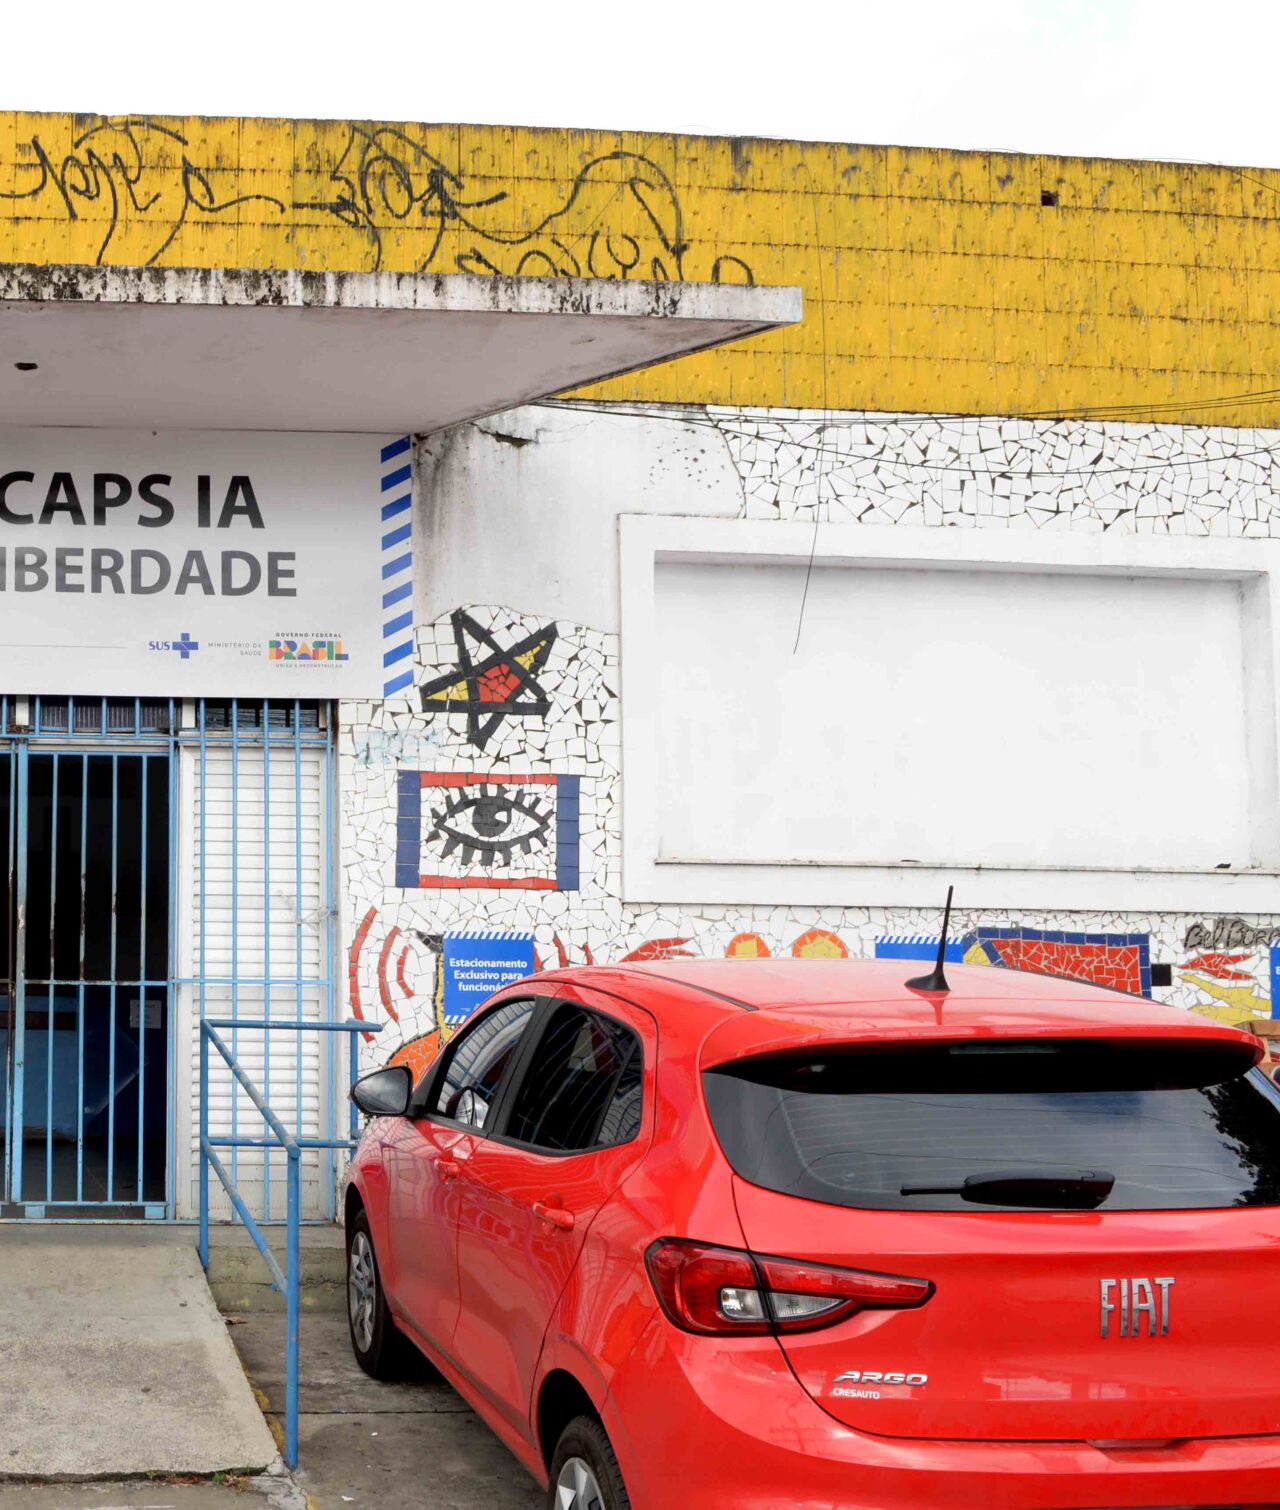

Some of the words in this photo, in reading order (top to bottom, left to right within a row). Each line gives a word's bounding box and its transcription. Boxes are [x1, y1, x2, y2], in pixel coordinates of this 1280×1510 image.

[197, 474, 265, 529] IA
[148, 640, 170, 651] SUS
[268, 640, 349, 661] BRASIL
[449, 957, 528, 968] Estacionamento
[453, 969, 500, 980] Exclusivo
[501, 972, 523, 982] para
[1100, 1277, 1175, 1338] FIAT
[833, 1370, 928, 1387] ARGO
[832, 1387, 880, 1400] CRESAUTO
